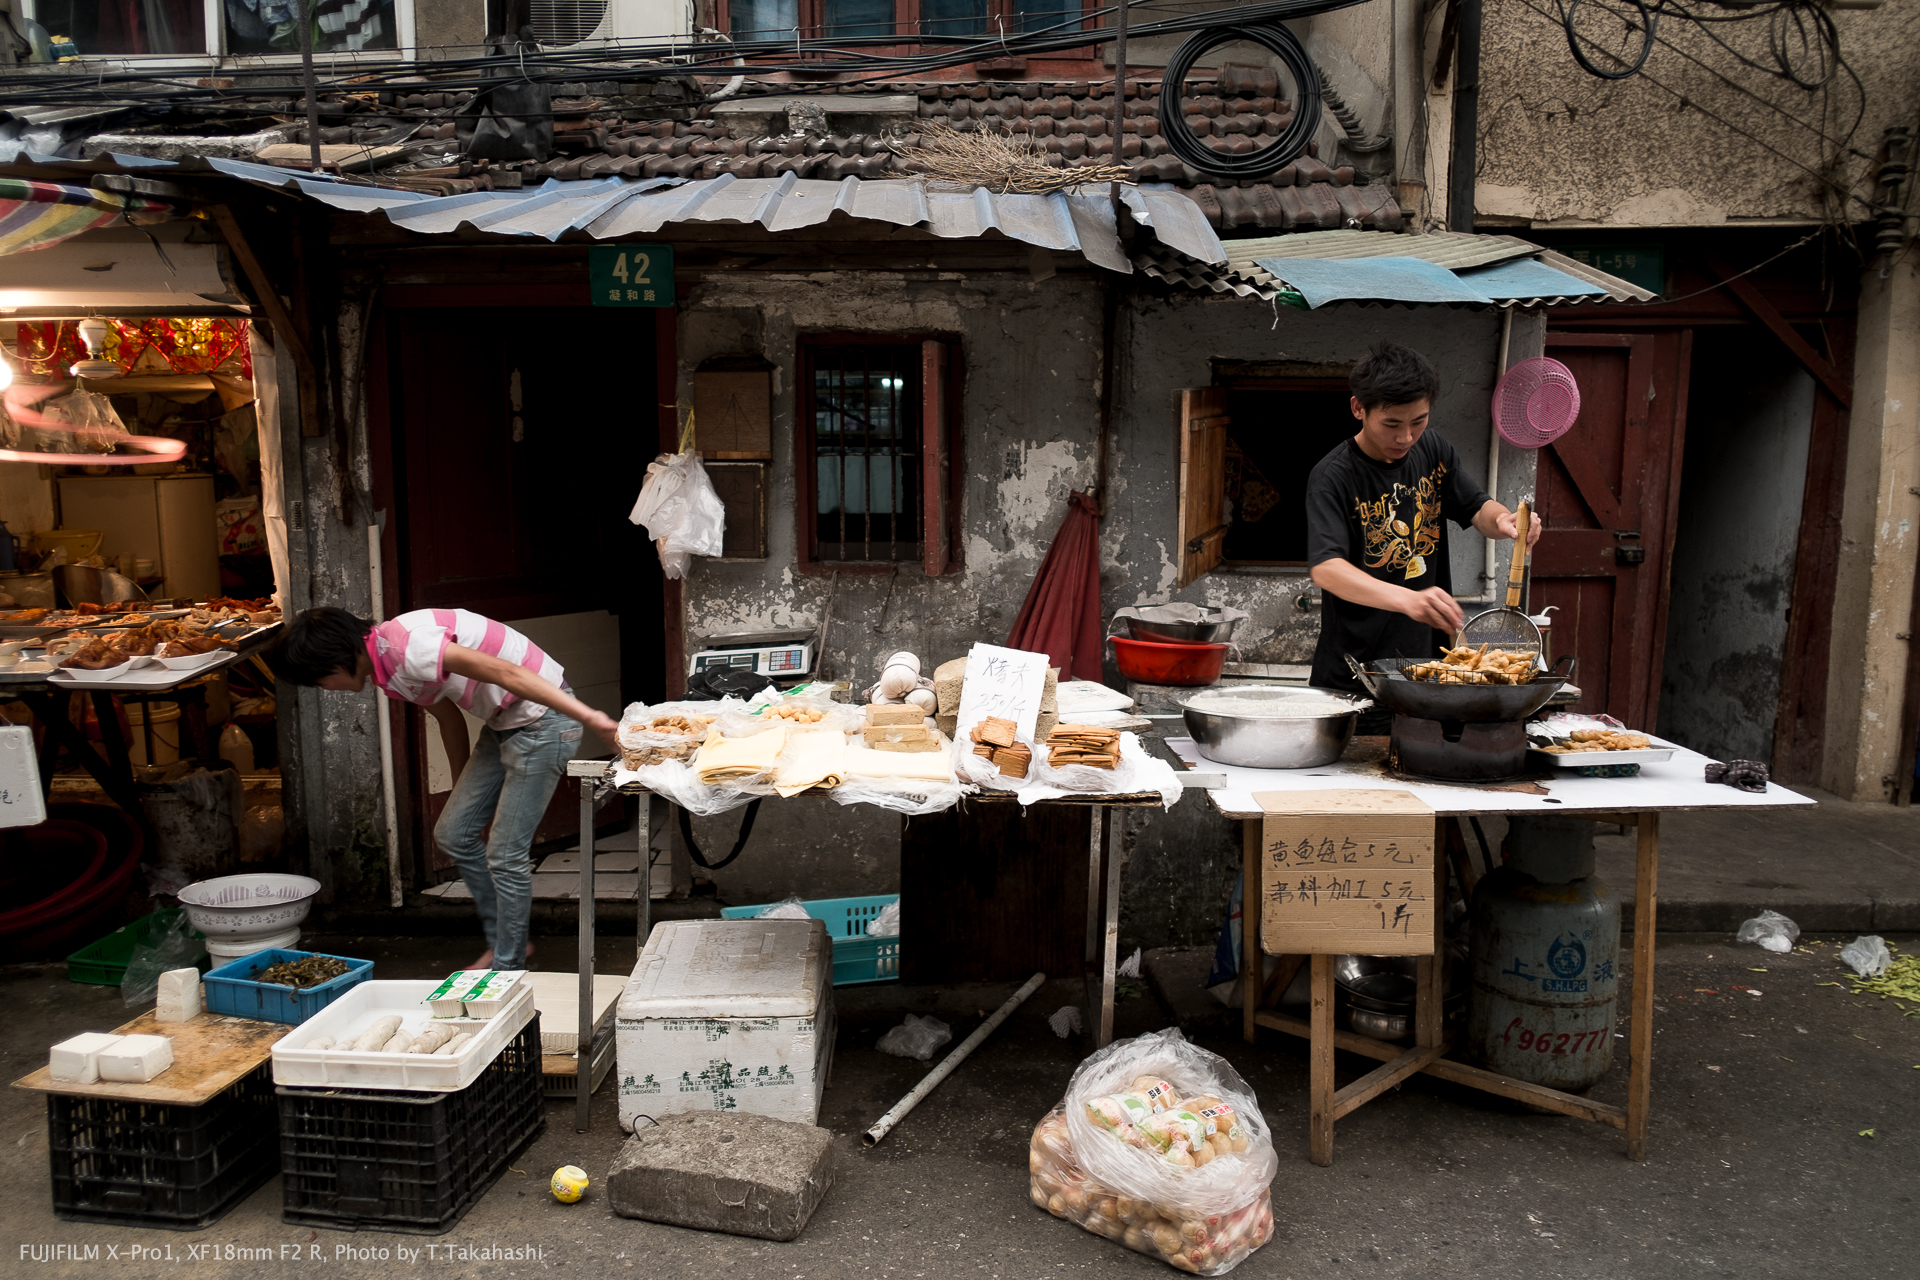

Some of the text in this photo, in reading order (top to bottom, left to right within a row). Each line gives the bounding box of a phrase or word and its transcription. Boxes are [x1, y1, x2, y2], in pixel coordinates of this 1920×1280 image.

[612, 252, 651, 284] 42
[609, 289, 656, 302] 凝和路
[1502, 956, 1615, 983] 上 液
[1545, 979, 1587, 992] S.H.LPG
[1517, 1026, 1609, 1055] 962777
